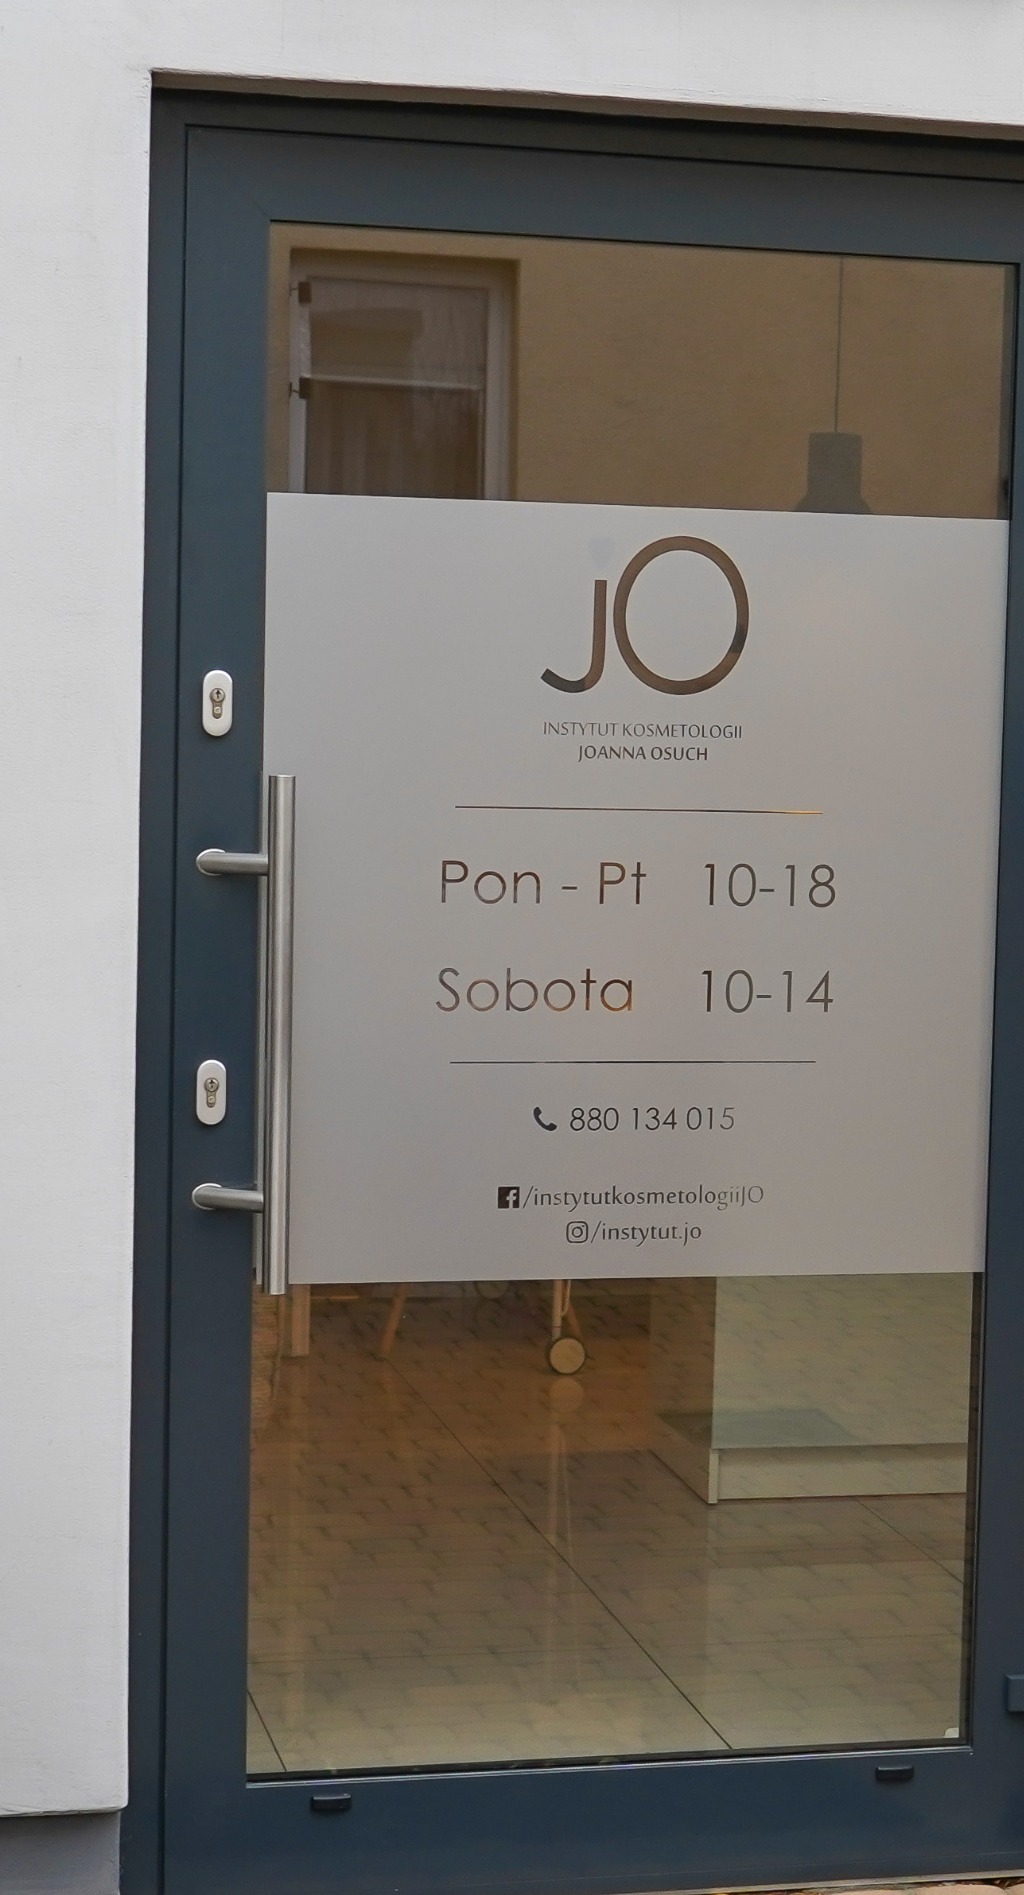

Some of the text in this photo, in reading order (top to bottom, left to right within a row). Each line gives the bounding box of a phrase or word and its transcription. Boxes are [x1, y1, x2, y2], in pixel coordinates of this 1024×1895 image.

[543, 721, 743, 740] INSTYTUT KOSMETOLOGII
[578, 745, 708, 763] JOANNA OSUCH
[440, 860, 541, 905] Pon
[598, 861, 647, 905] Pt
[703, 863, 836, 909] 10-18
[435, 967, 834, 1014] Sobota 10-14
[569, 1106, 736, 1132] 880 134 015
[590, 1220, 703, 1248] /instytut.jo
